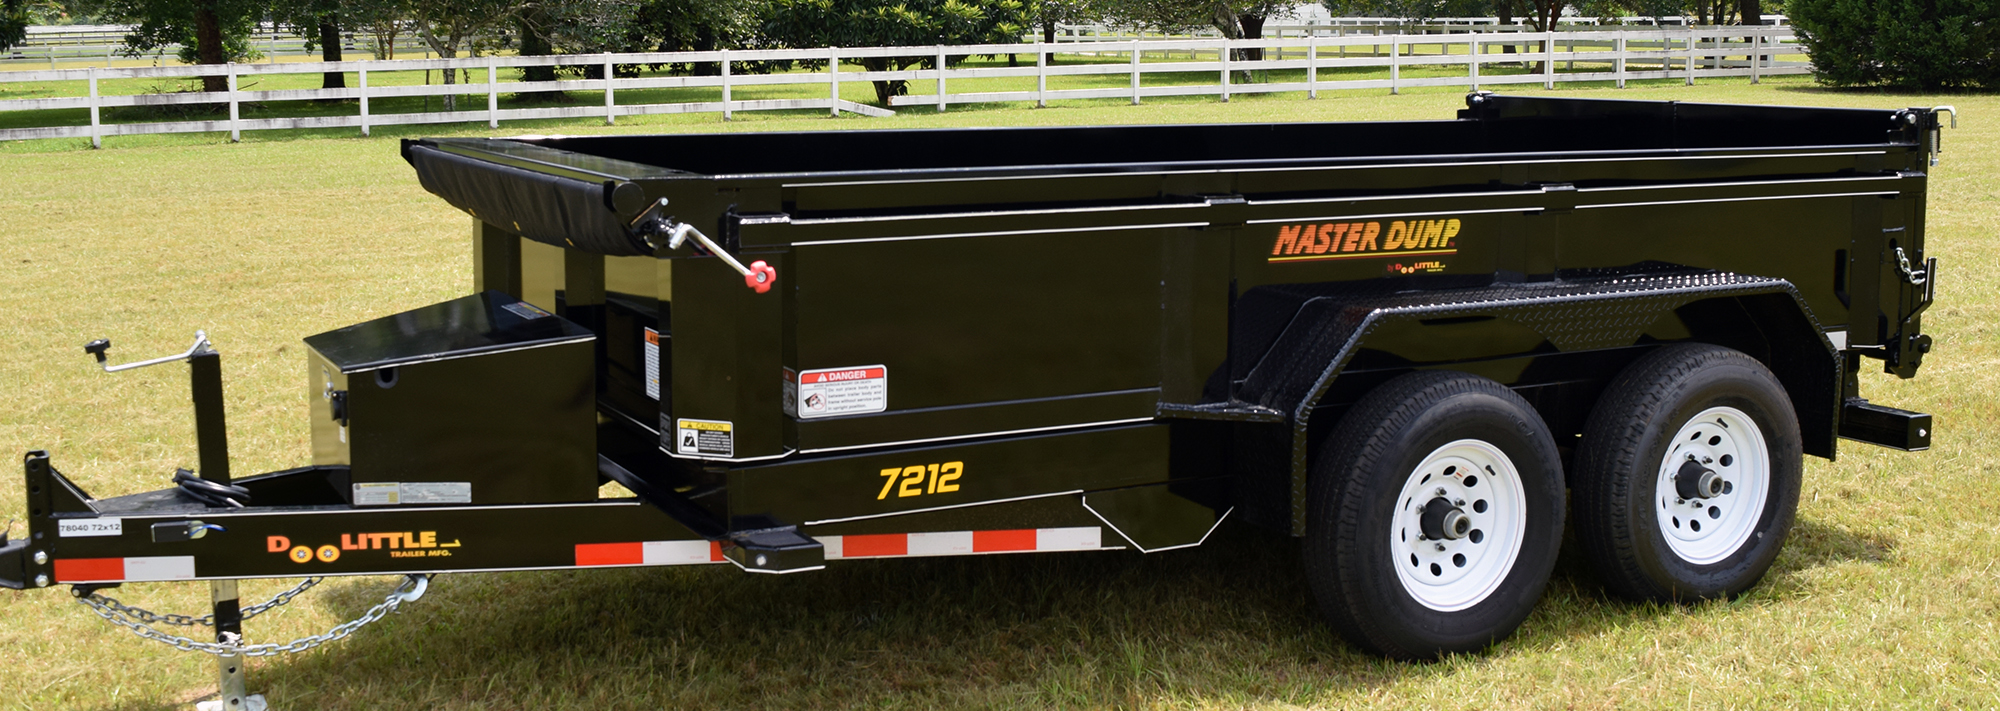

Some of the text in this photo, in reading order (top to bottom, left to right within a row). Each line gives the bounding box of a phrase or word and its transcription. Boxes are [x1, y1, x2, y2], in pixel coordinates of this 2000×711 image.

[1272, 218, 1461, 255] MASTER DUMP
[829, 370, 867, 381] DANGER
[695, 422, 724, 430] CAUTION
[877, 461, 964, 500] 7212
[60, 523, 121, 532] 78040 72x12
[390, 549, 452, 558] TRAILER MFG.
